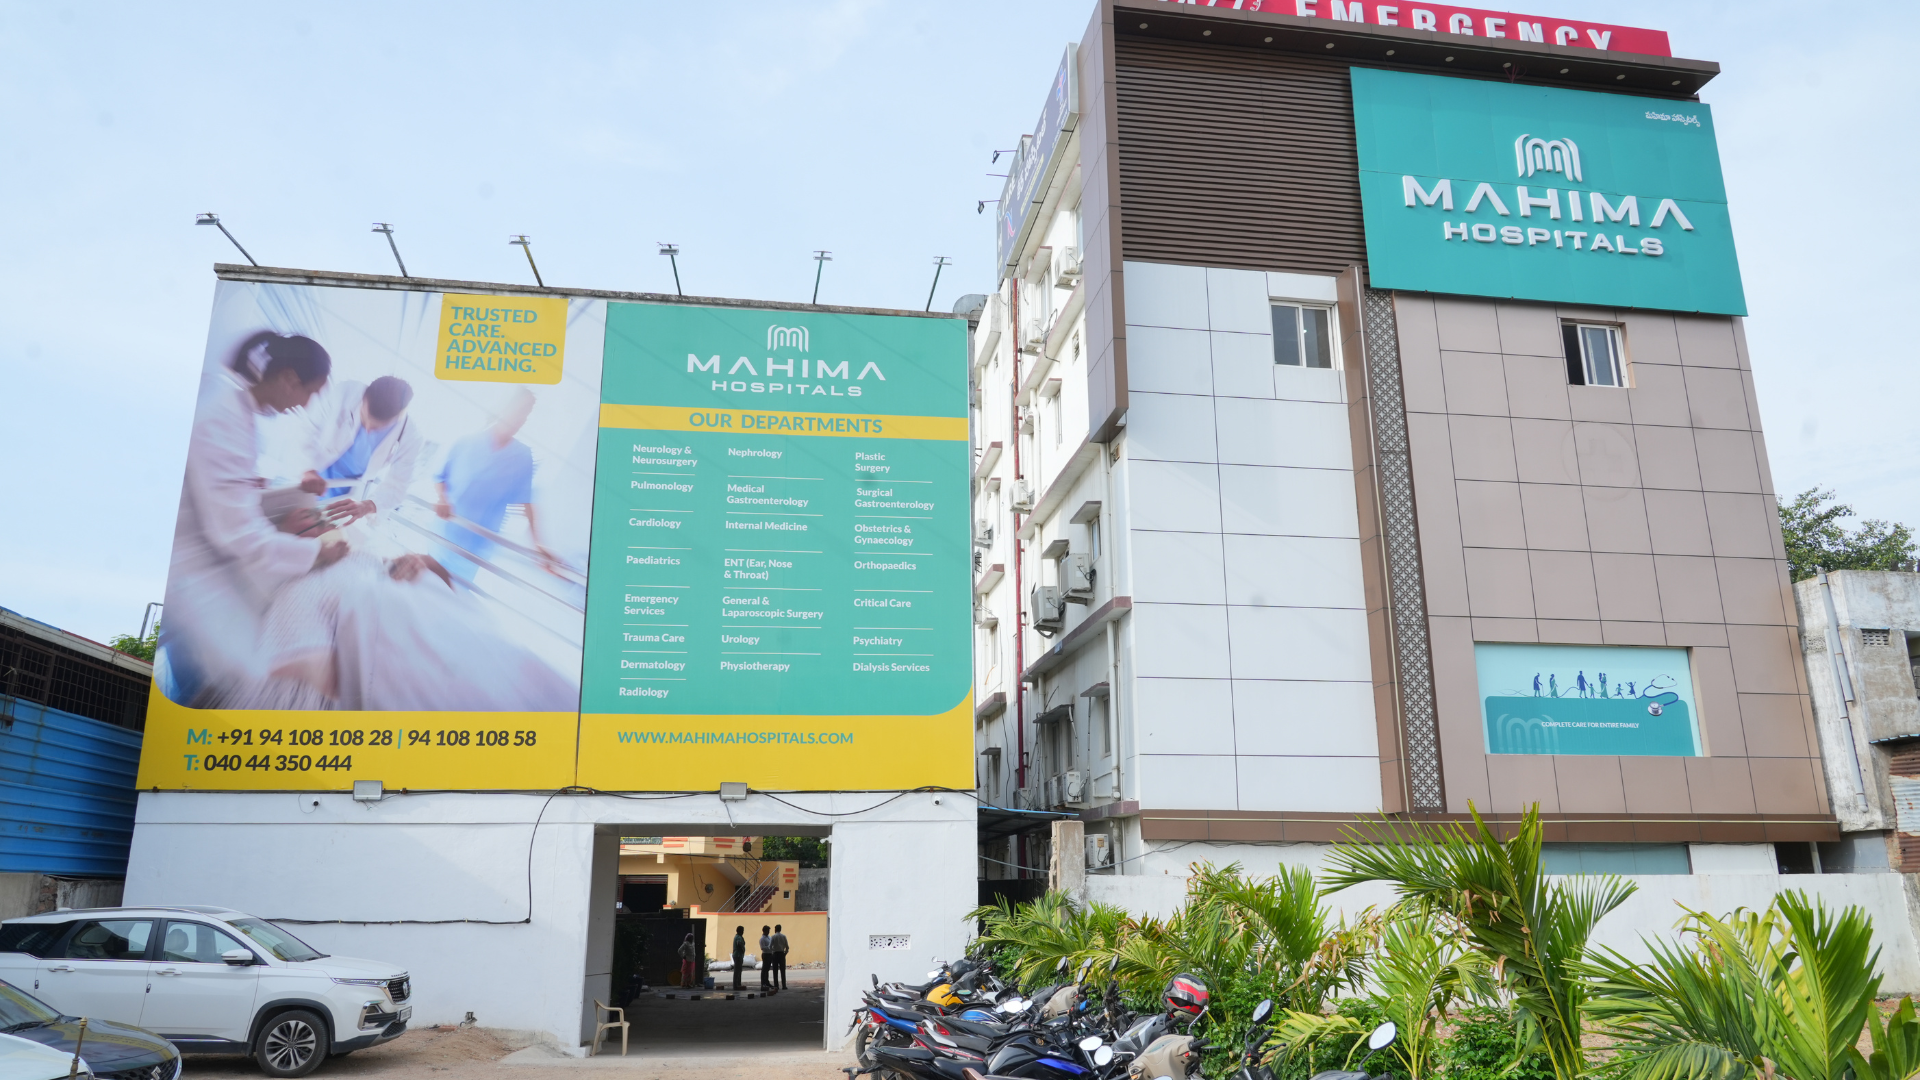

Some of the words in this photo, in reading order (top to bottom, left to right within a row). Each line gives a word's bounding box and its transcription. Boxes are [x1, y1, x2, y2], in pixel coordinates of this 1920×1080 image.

[1402, 175, 1695, 232] MAHIMA
[1444, 221, 1664, 257] HOSPITALS
[451, 306, 538, 324] TRUSTED
[449, 323, 505, 338] CARE.
[446, 339, 557, 358] ADVANCED
[446, 355, 536, 372] HEALING.
[687, 354, 886, 380] MAHIMA
[712, 381, 862, 396] HOSPITALS
[689, 412, 732, 428] OUR
[741, 413, 883, 434] DEPARTMENTS
[632, 443, 683, 456] Neurology
[683, 445, 692, 455] &
[728, 447, 783, 460] Nephrology
[855, 451, 886, 461] Plastic
[632, 455, 698, 468] Neurosurgery
[854, 463, 891, 474] Surgery
[630, 480, 694, 493] Pulmonology
[727, 483, 765, 493] Medical
[856, 487, 893, 498] Surgical
[726, 495, 809, 508] Gastroenterology
[854, 498, 935, 511] Gastroenterology
[628, 517, 682, 530] Cardiology
[725, 520, 763, 530] Internal
[764, 521, 808, 532] Medicine
[854, 523, 903, 534] Obstetrics
[903, 524, 912, 534] &
[853, 535, 914, 547] Gynaecology
[626, 555, 681, 566] Paediatrics
[724, 558, 745, 567] ENT
[745, 558, 767, 569] (Ear,
[768, 559, 793, 569] Nose
[853, 560, 917, 572] Orthopaedics
[723, 569, 732, 579] &
[732, 570, 769, 581] Throat)
[624, 593, 679, 605] Emergency
[722, 595, 761, 606] General
[761, 596, 770, 606] &
[853, 598, 888, 608] Critical
[888, 598, 912, 608] Care
[623, 605, 666, 616] Services
[722, 607, 786, 619] Laparoscopic
[786, 608, 824, 620] Surgery
[622, 632, 660, 642] Trauma
[661, 633, 686, 643] Care
[721, 634, 761, 646] Urology
[853, 636, 903, 647] Psychiatry
[620, 659, 686, 672] Dermatology
[720, 661, 791, 673] Physiotherapy
[852, 662, 890, 673] Dialysis
[890, 662, 931, 672] Services
[618, 686, 670, 699] Radiology
[187, 729, 212, 745] M:
[218, 729, 253, 745] +91
[260, 729, 282, 745] 94
[289, 730, 323, 745] 108
[330, 730, 364, 746] 108
[369, 730, 392, 745] 28
[408, 730, 431, 745] 94
[437, 730, 470, 746] 108
[476, 731, 509, 746] 108
[514, 731, 536, 746] 58
[617, 731, 854, 745] WWW.MAHIMAHOSPITALS.COM
[184, 755, 199, 770] T:
[204, 755, 241, 771] 040
[245, 755, 270, 771] 44
[275, 755, 311, 771] 350
[315, 755, 352, 771] 444
